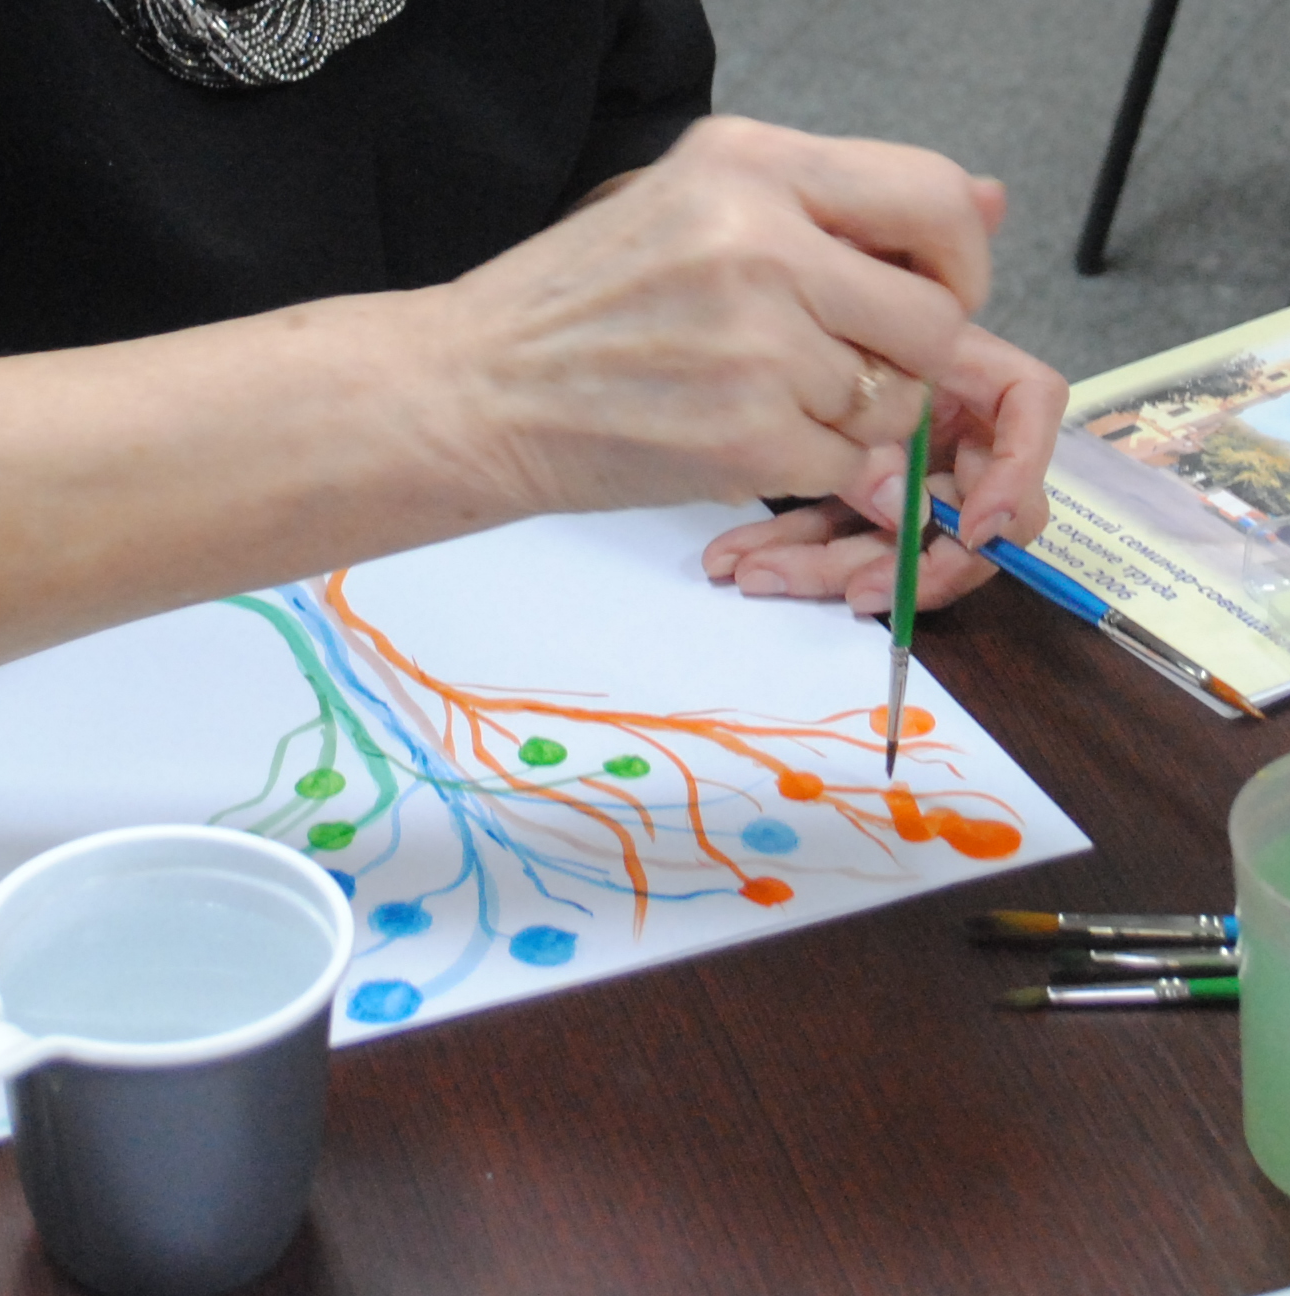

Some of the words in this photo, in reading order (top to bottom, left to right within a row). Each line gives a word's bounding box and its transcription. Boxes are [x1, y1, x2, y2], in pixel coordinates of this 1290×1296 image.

[1056, 522, 1124, 565] охране
[1122, 565, 1179, 602] труда
[1083, 568, 1139, 602] 2006
